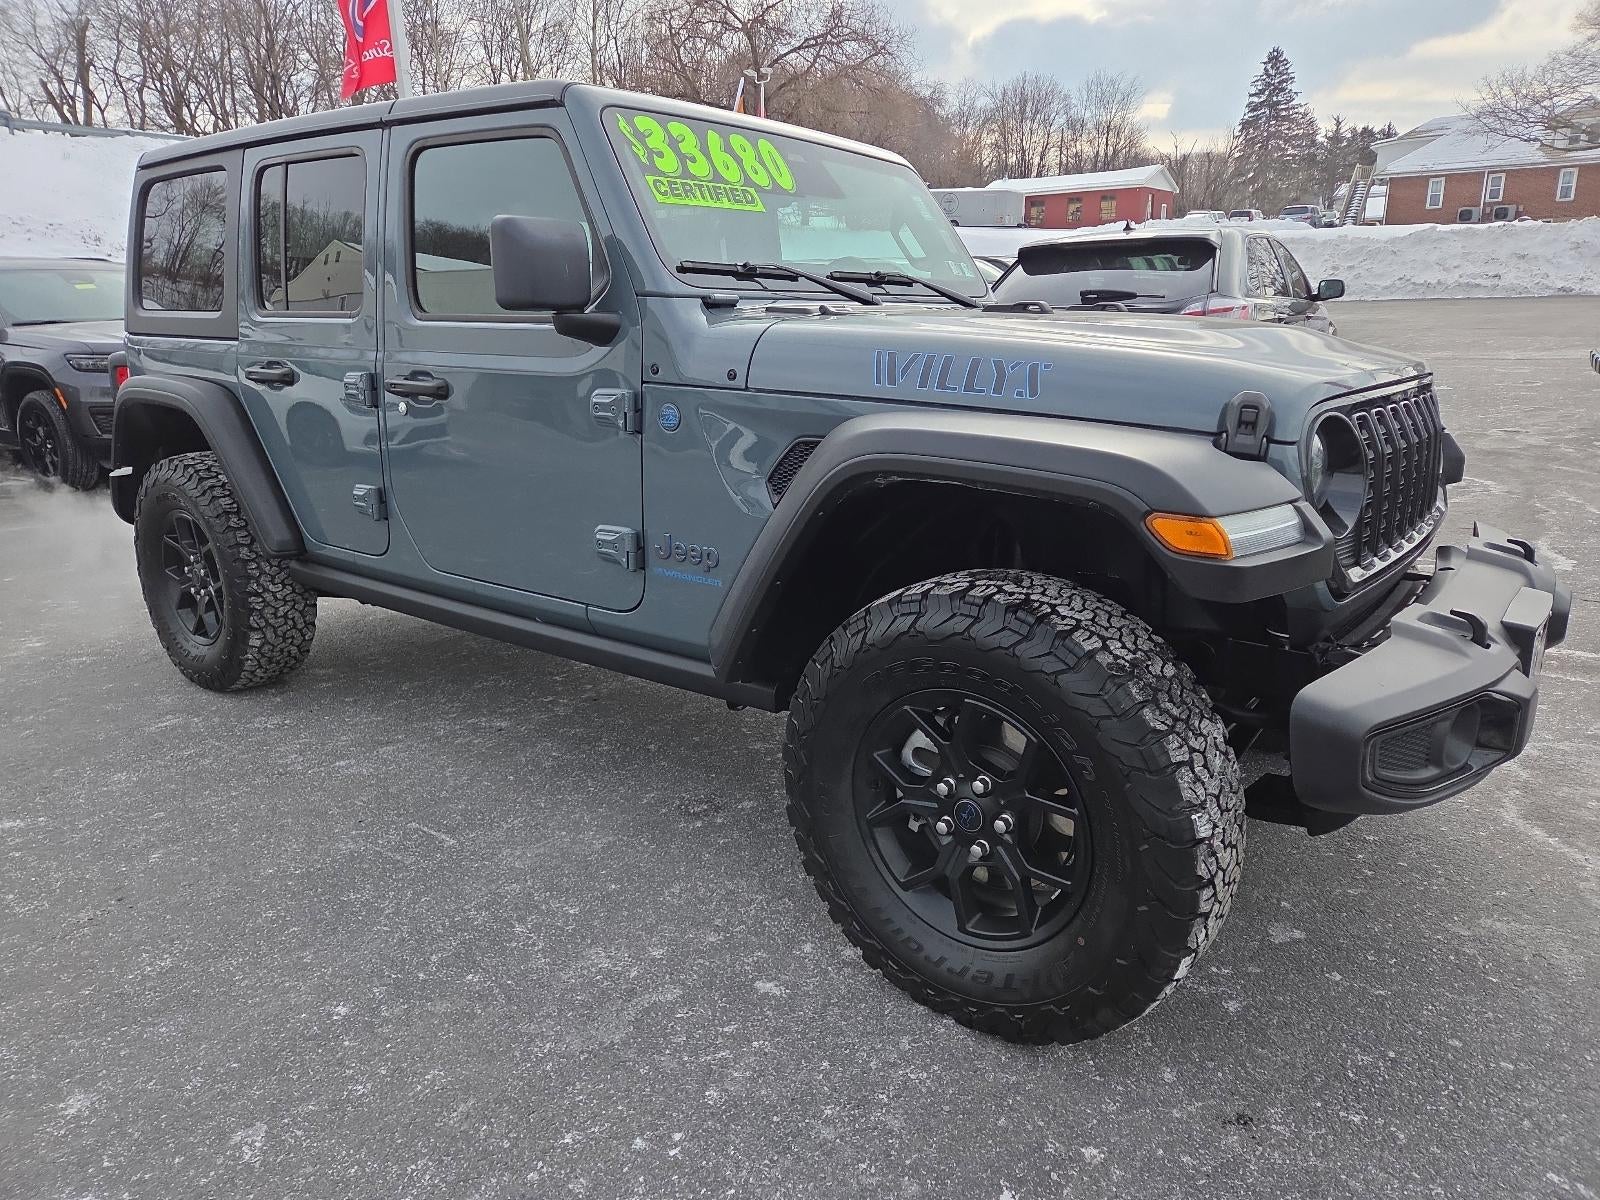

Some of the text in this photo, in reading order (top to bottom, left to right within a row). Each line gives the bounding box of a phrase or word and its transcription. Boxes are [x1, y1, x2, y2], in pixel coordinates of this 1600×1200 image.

[616, 112, 796, 193] $33680
[653, 179, 756, 206] CERTIFIED
[874, 349, 1054, 400] WILLYS
[654, 532, 719, 573] Jeep
[663, 567, 722, 587] WRANGLER
